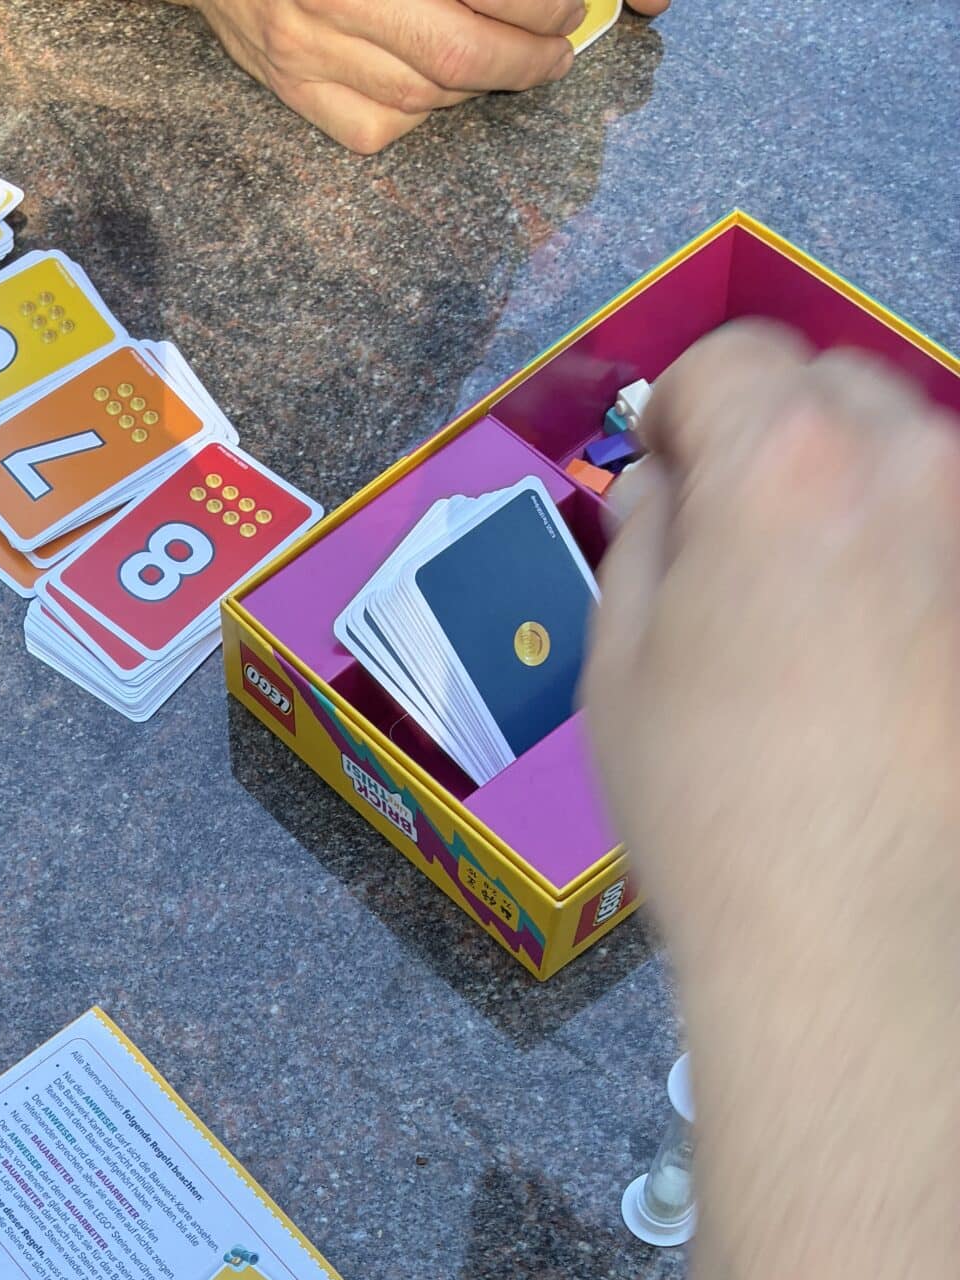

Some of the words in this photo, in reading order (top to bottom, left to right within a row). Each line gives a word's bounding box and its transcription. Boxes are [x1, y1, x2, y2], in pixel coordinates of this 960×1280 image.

[0, 429, 106, 501] 7
[118, 522, 215, 602] 8
[246, 664, 291, 713] LEGO
[344, 760, 390, 801] THIS!
[352, 779, 414, 835] BRICK
[595, 879, 627, 926] LEGO
[70, 1050, 85, 1065] Alle
[82, 1062, 103, 1086] Teams
[99, 1084, 125, 1112] müssen
[121, 1109, 152, 1144] folgende
[149, 1140, 174, 1169] Regeln
[9, 1109, 24, 1124] Nur
[20, 1123, 34, 1136] der
[30, 1133, 75, 1185] BAUARBEITER
[70, 1184, 89, 1199] darf
[82, 1197, 95, 1211] die
[110, 1230, 132, 1255] Steine
[2, 1206, 25, 1231] dieser
[43, 1257, 62, 1278] muss
